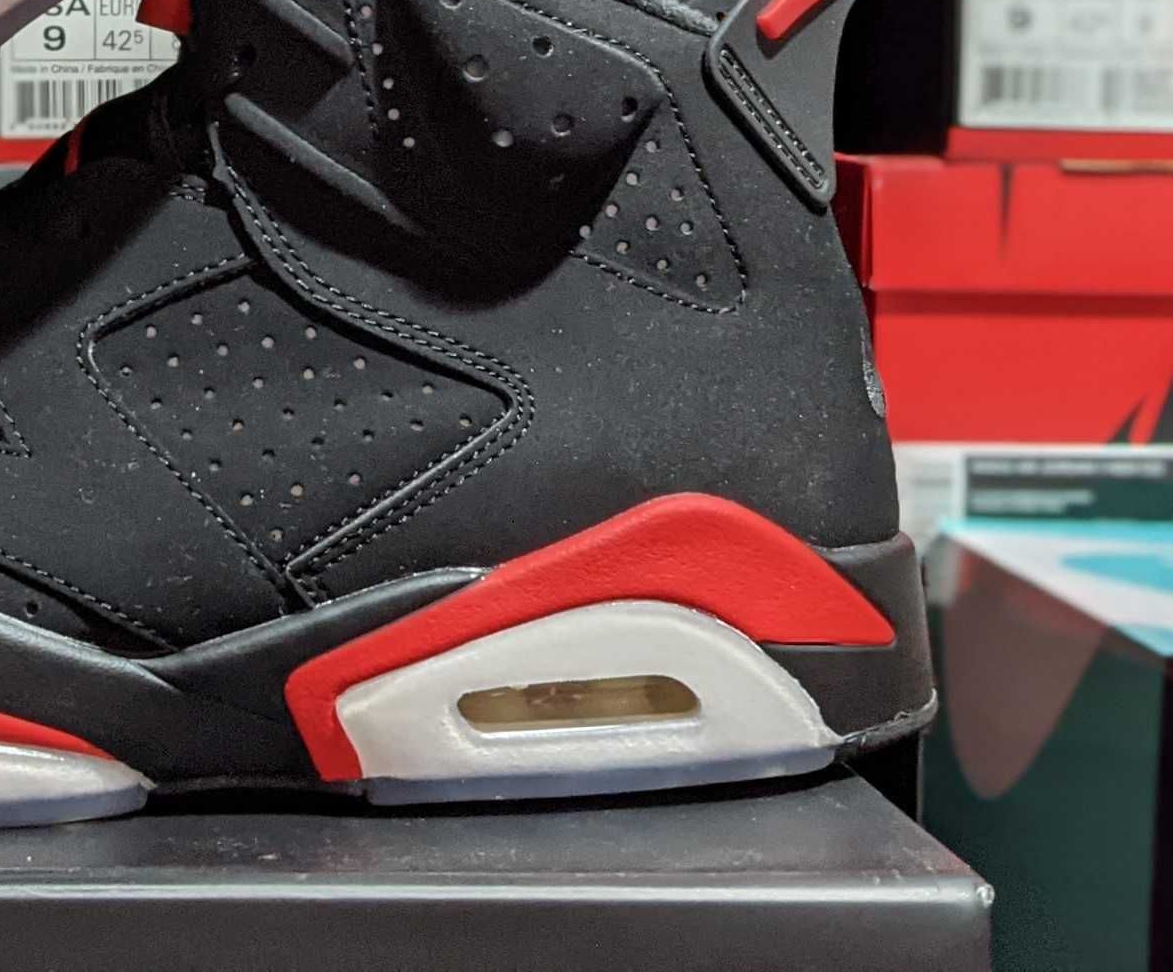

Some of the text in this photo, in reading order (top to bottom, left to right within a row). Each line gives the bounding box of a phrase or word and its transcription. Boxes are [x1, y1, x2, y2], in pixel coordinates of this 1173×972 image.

[43, 26, 66, 52] 9
[51, 64, 79, 74] China
[87, 64, 129, 75] Fabrique
[132, 65, 145, 74] en
